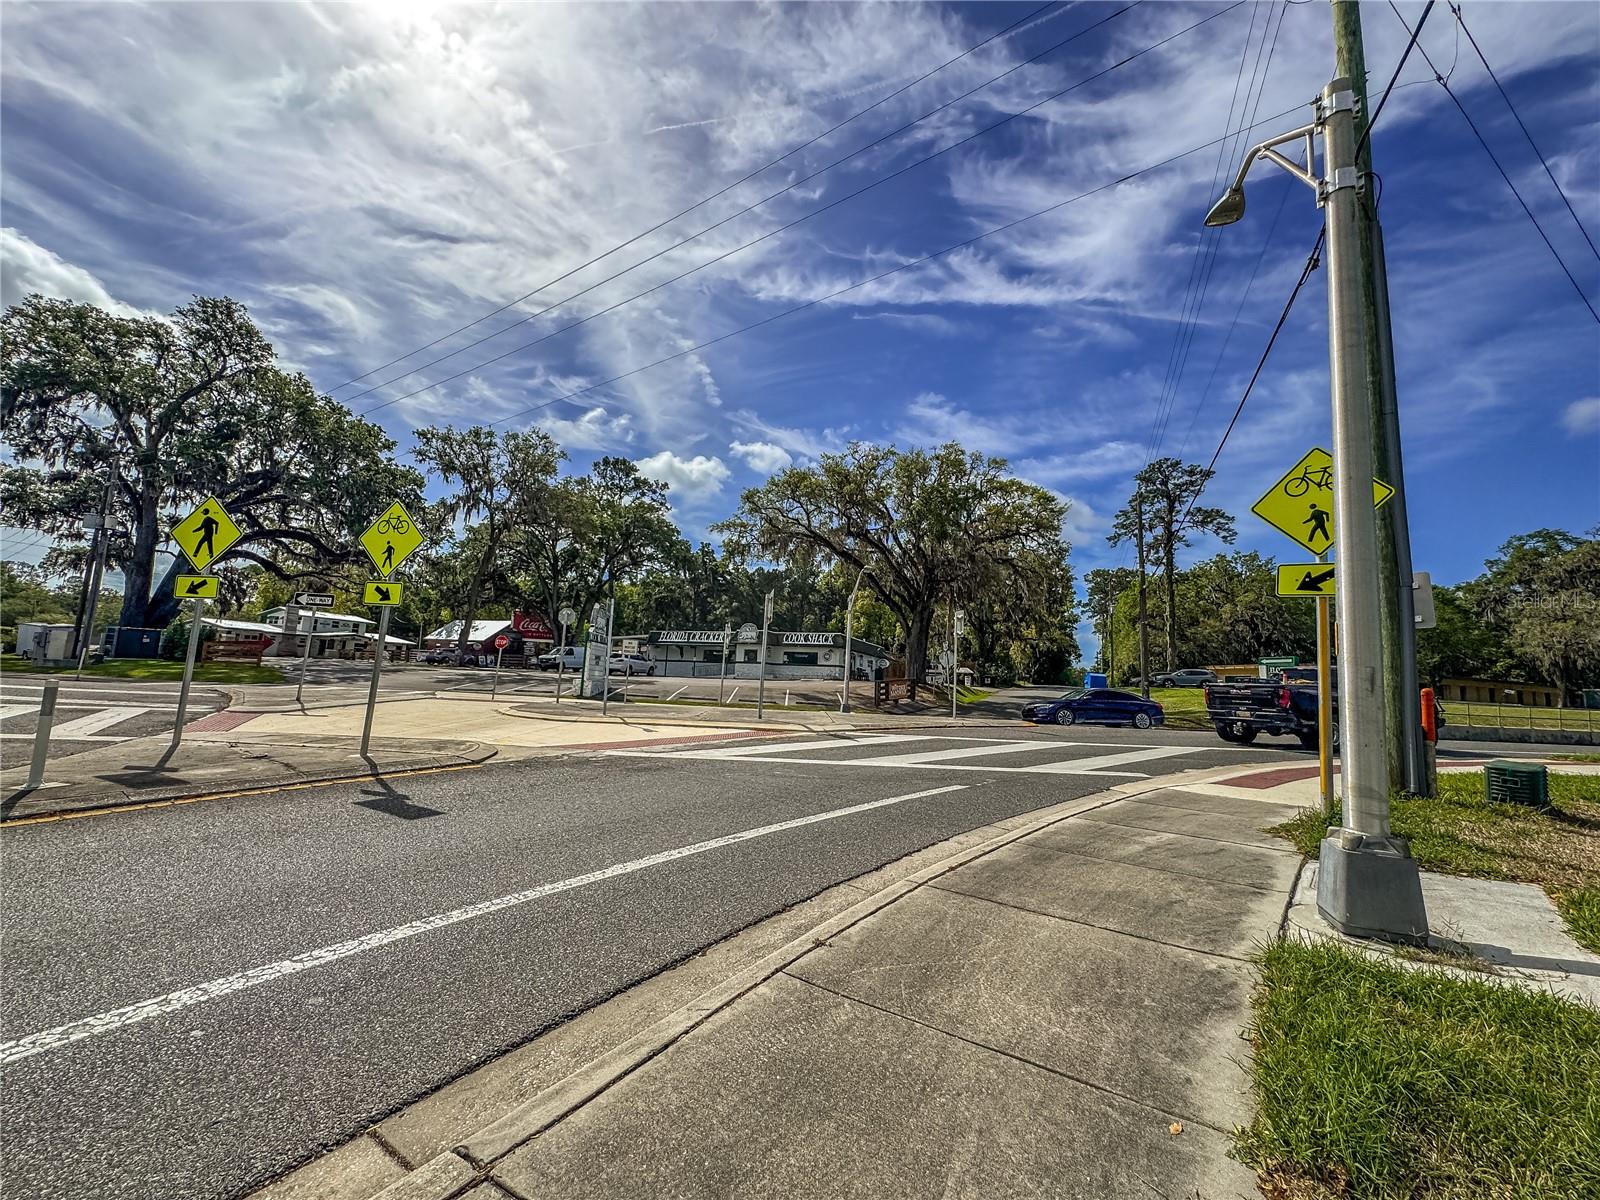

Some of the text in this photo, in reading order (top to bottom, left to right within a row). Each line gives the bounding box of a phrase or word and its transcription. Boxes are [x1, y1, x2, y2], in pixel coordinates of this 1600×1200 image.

[306, 596, 317, 604] ONE
[658, 631, 724, 643] FLORIDA CRACKER
[782, 633, 834, 645] COOK SHACK
